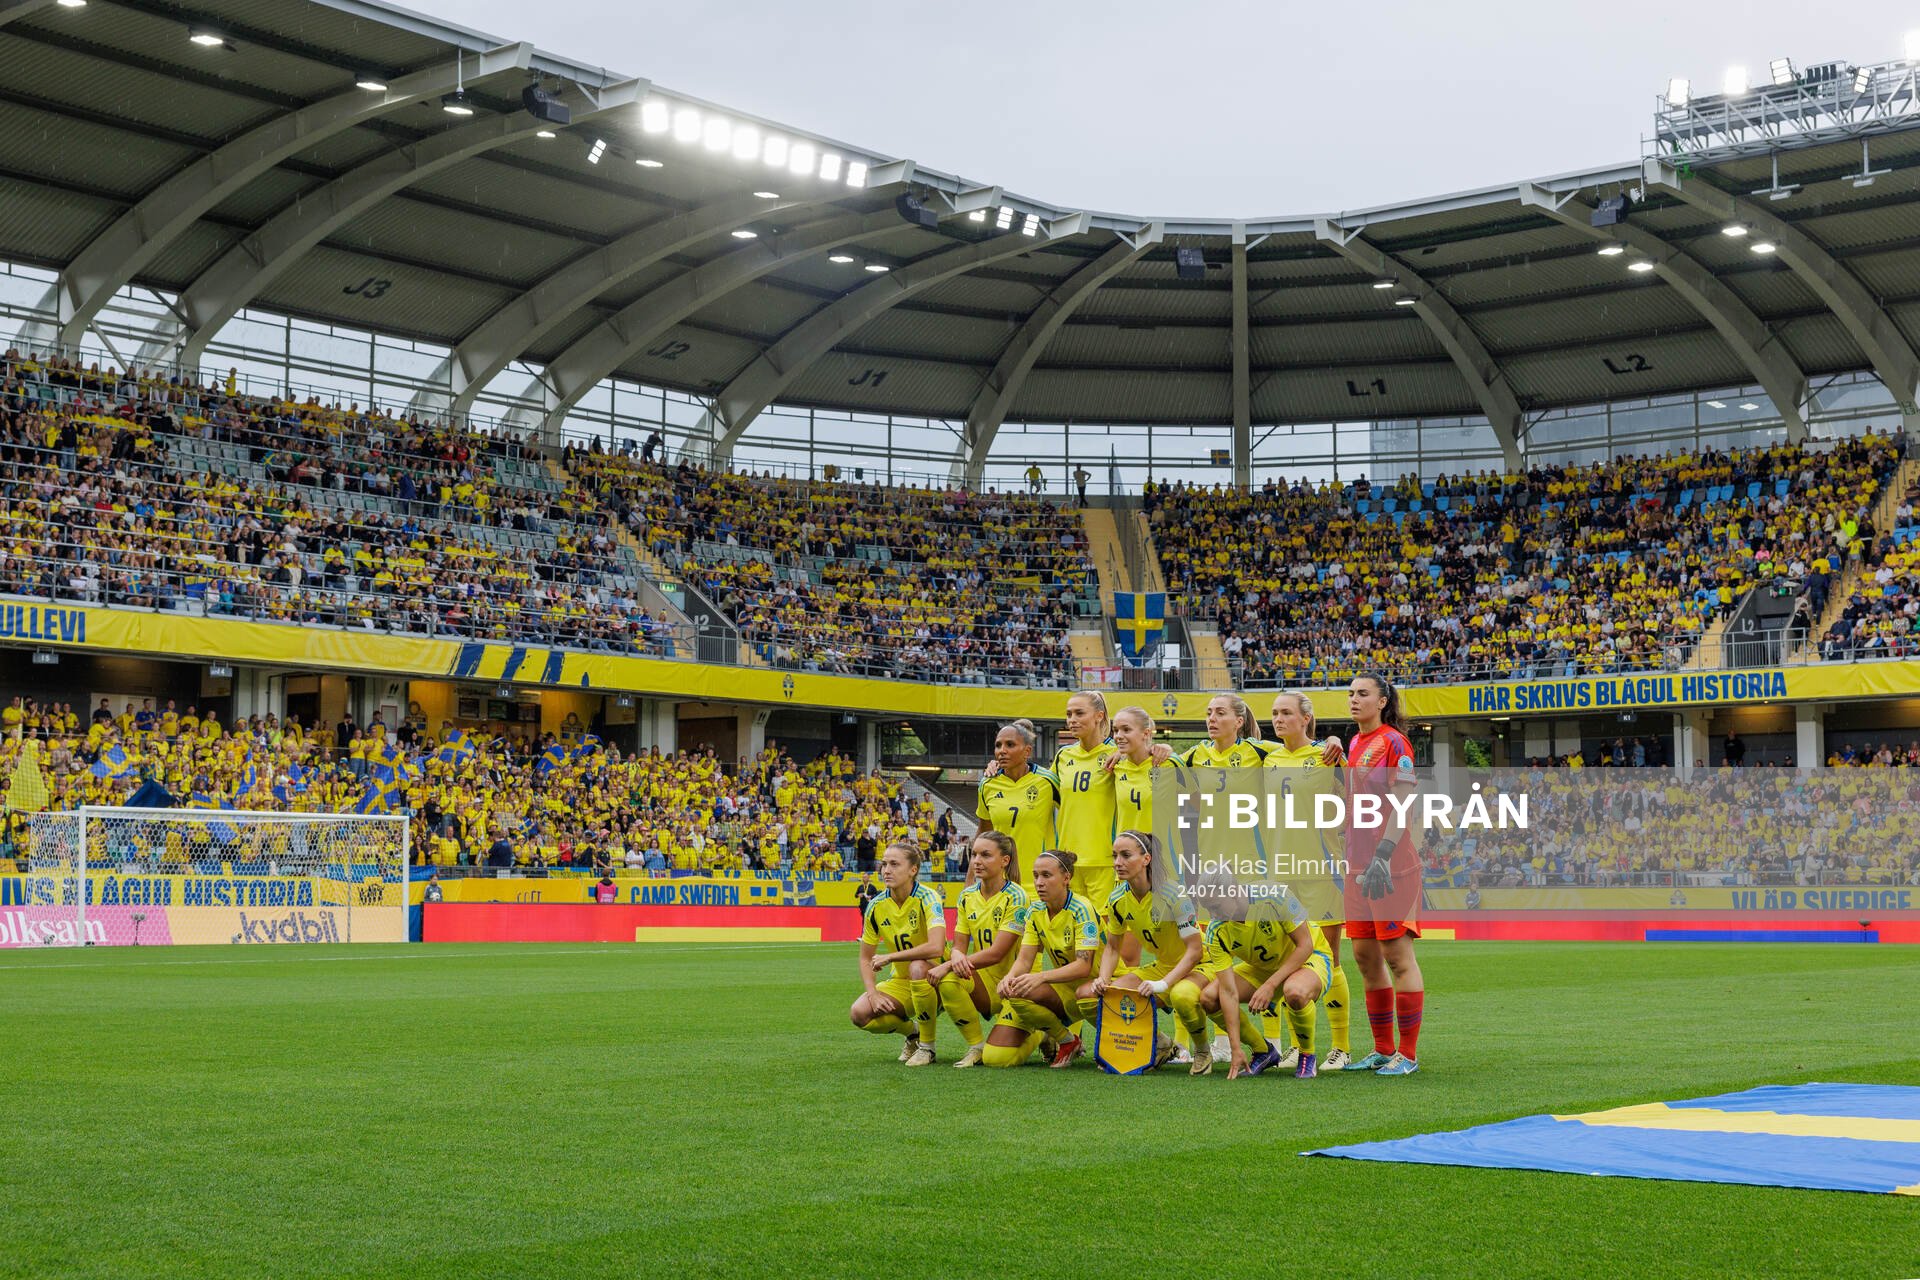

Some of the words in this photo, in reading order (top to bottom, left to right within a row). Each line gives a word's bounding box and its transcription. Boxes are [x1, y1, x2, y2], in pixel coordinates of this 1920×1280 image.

[342, 277, 392, 298] J3
[647, 341, 690, 360] J2
[1602, 355, 1654, 375] L2
[848, 369, 888, 387] J1
[1346, 379, 1387, 396] L1
[0, 603, 86, 643] ULLEVI
[1469, 685, 1511, 712] HÄR
[1515, 682, 1591, 710] SKRIVS
[1596, 677, 1678, 705] BLÅGUL
[1682, 671, 1788, 700] HISTORIA
[1072, 771, 1092, 792] 18
[1216, 769, 1227, 792] 3
[1281, 776, 1293, 800] 6
[1130, 788, 1141, 811] 4
[1008, 806, 1019, 828] 7
[631, 885, 675, 904] CAMP
[680, 884, 740, 905] SWEDEN
[1803, 890, 1912, 910] SVERIGE
[893, 933, 914, 953] 16
[978, 928, 993, 951] 19
[1142, 929, 1159, 949] 9
[1254, 945, 1276, 962] 2
